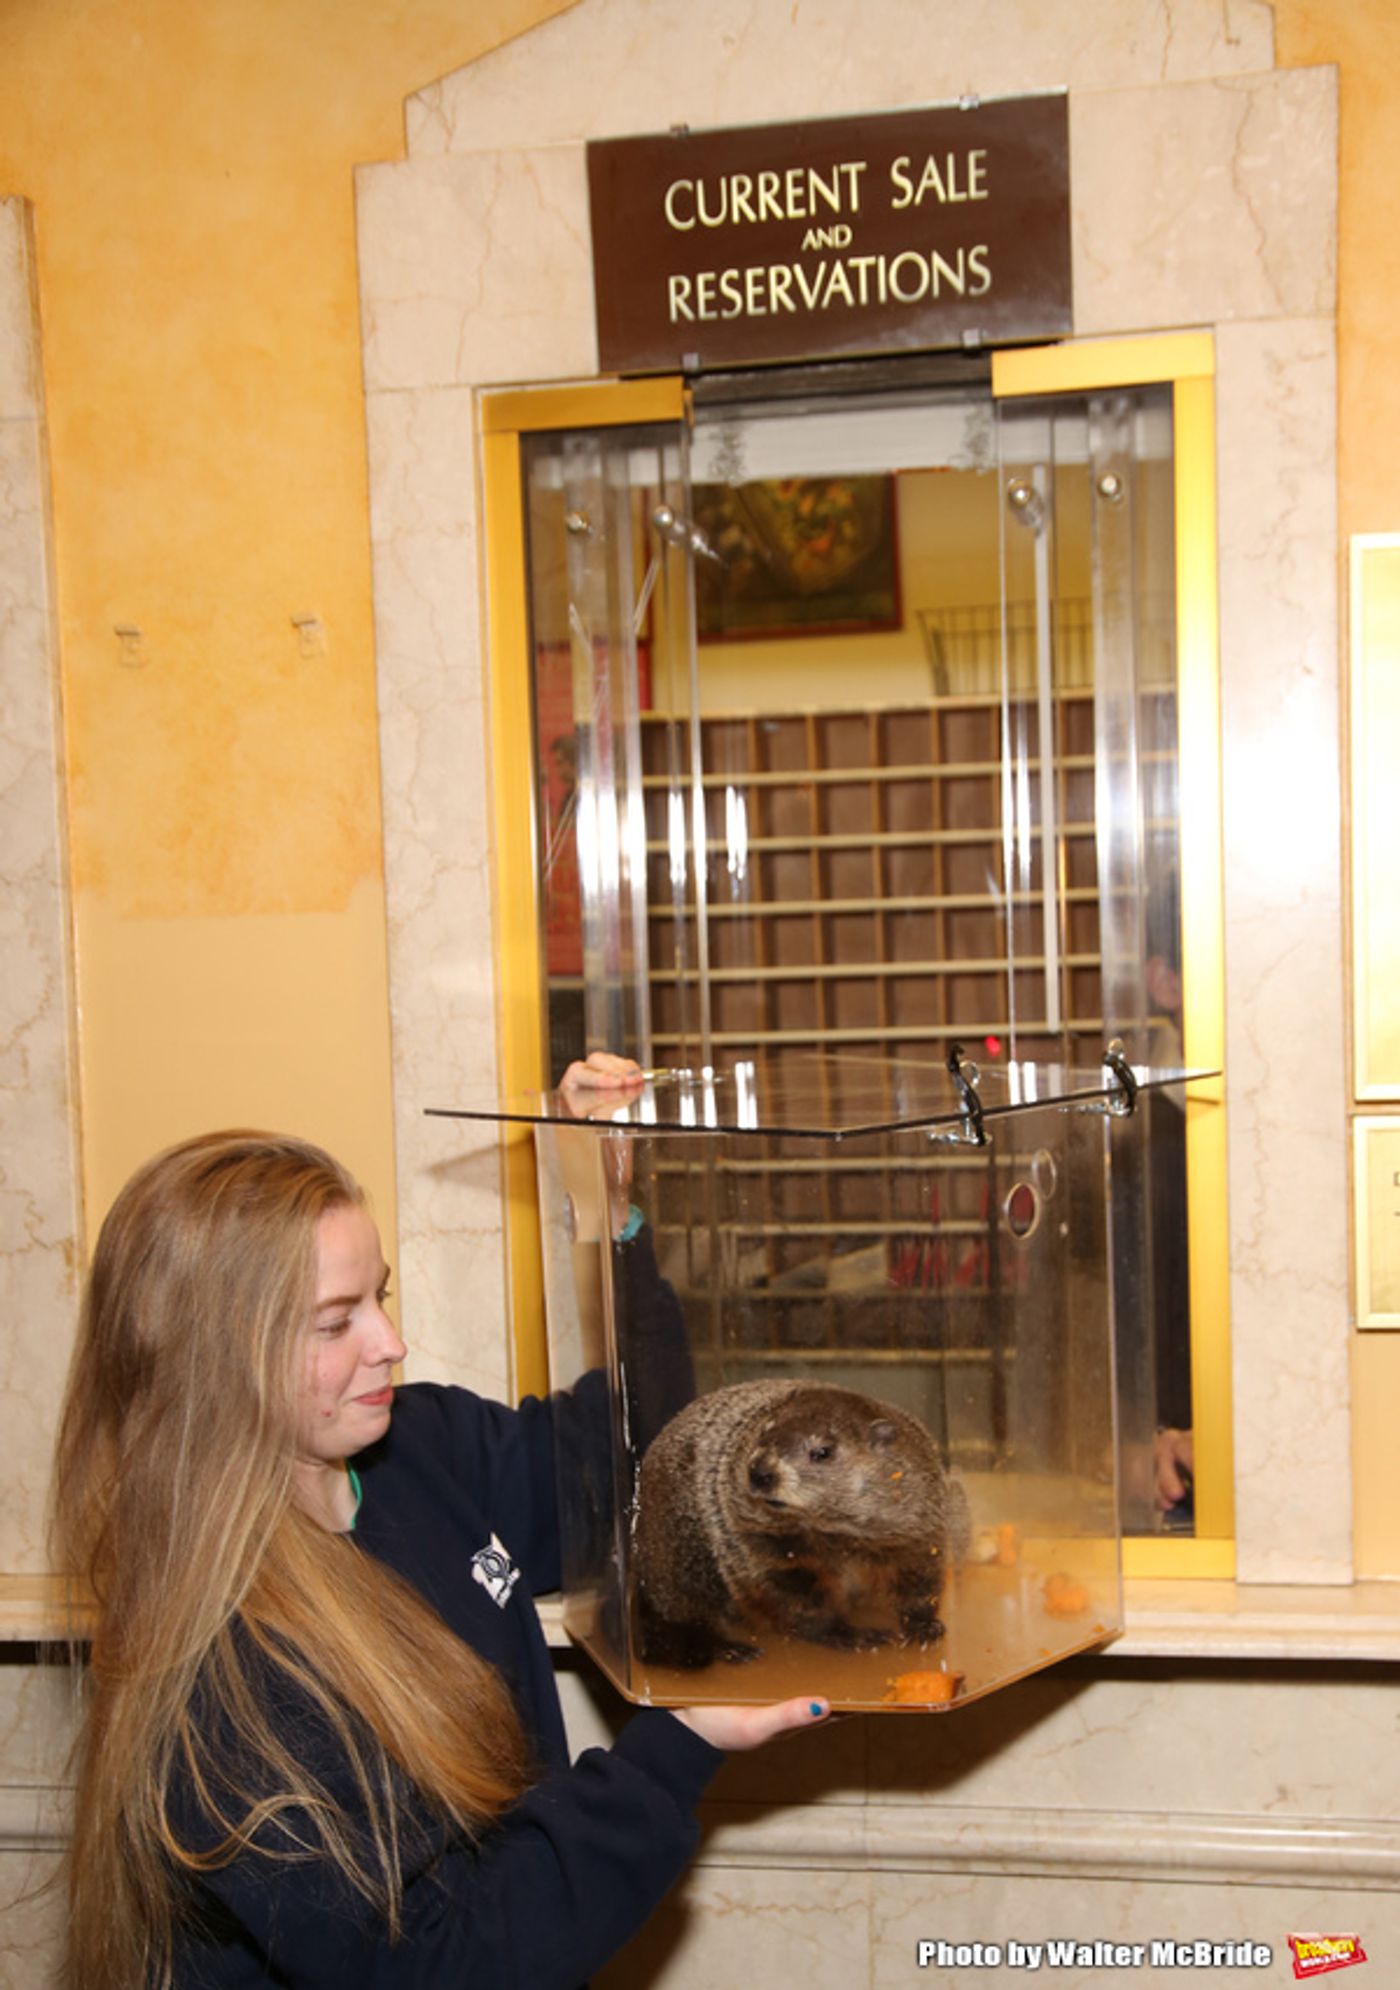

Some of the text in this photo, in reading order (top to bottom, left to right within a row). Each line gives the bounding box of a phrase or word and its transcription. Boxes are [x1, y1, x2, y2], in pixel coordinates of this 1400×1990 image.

[664, 149, 989, 231] CURRENT SALE
[801, 224, 853, 251] AND
[668, 245, 992, 323] RESERVATIONS
